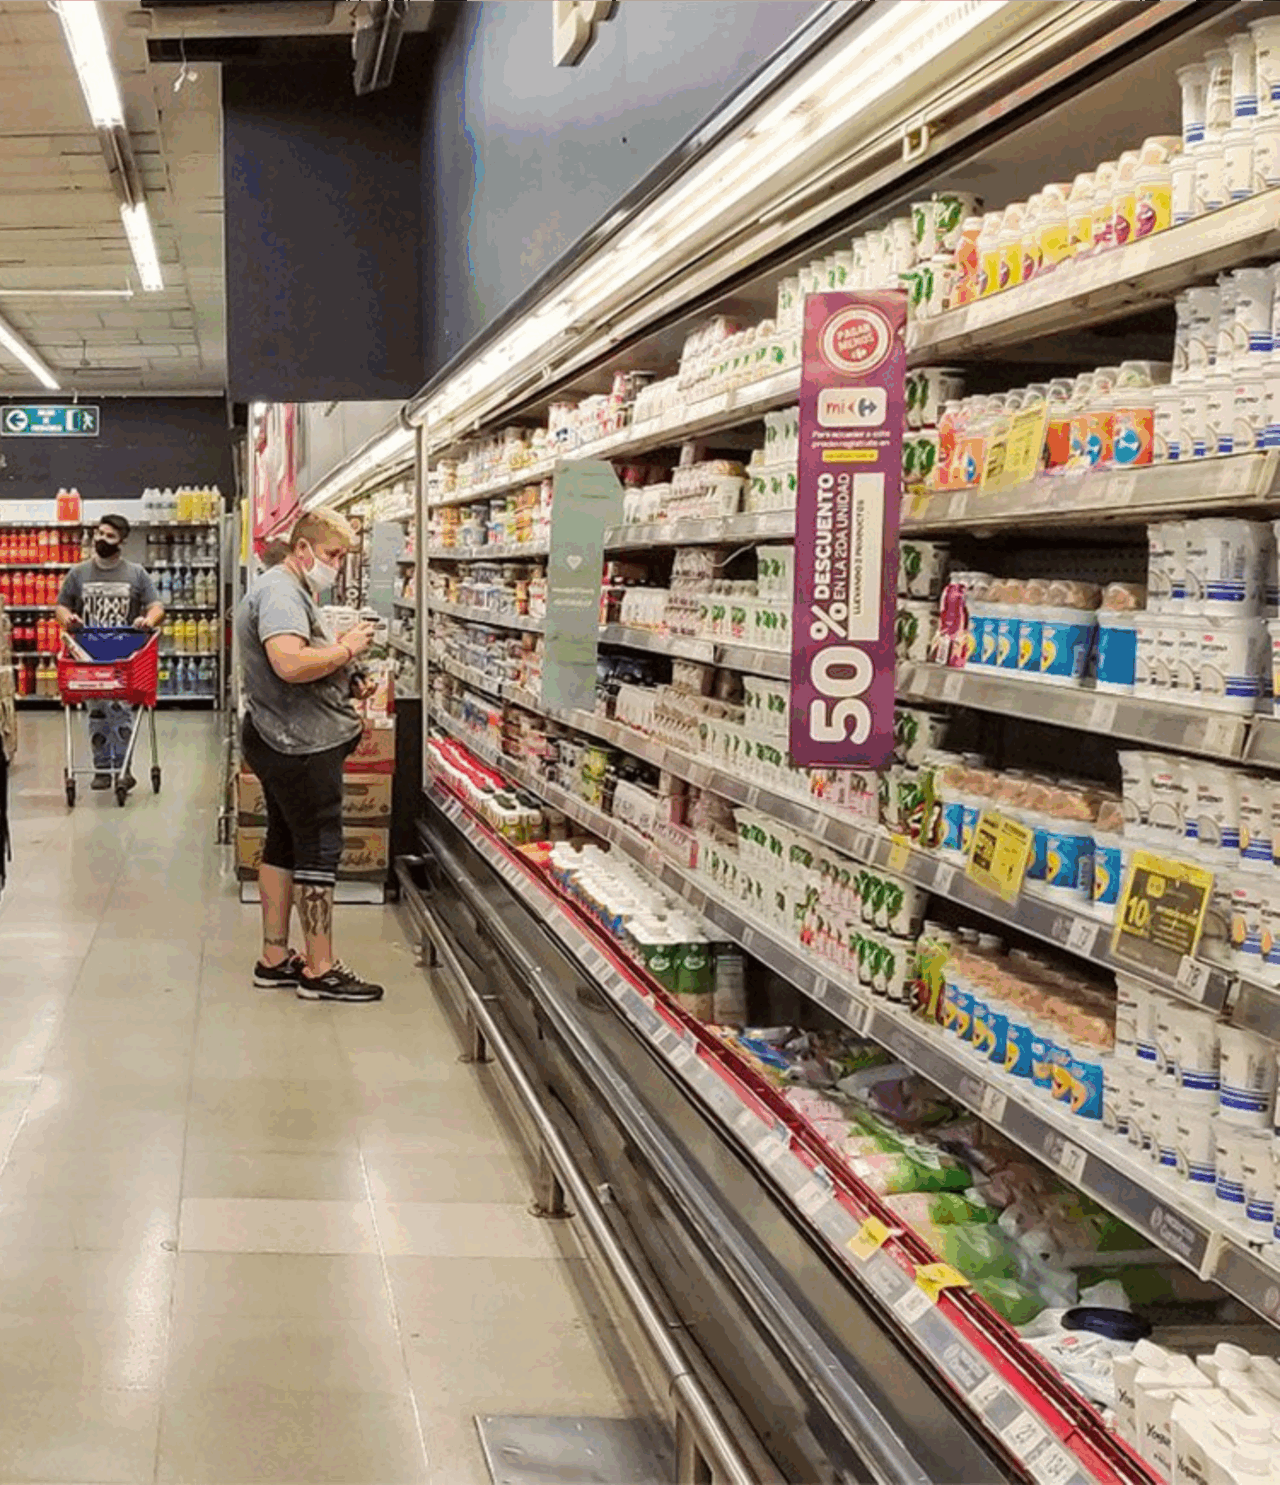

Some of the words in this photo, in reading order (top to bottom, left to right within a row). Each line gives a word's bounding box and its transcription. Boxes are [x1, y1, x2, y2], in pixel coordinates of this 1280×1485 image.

[835, 472, 851, 528] UNIDAD
[813, 472, 835, 600] DESCUENTO
[834, 530, 849, 558] 2DA
[834, 561, 847, 579] LA
[833, 579, 847, 600] EN
